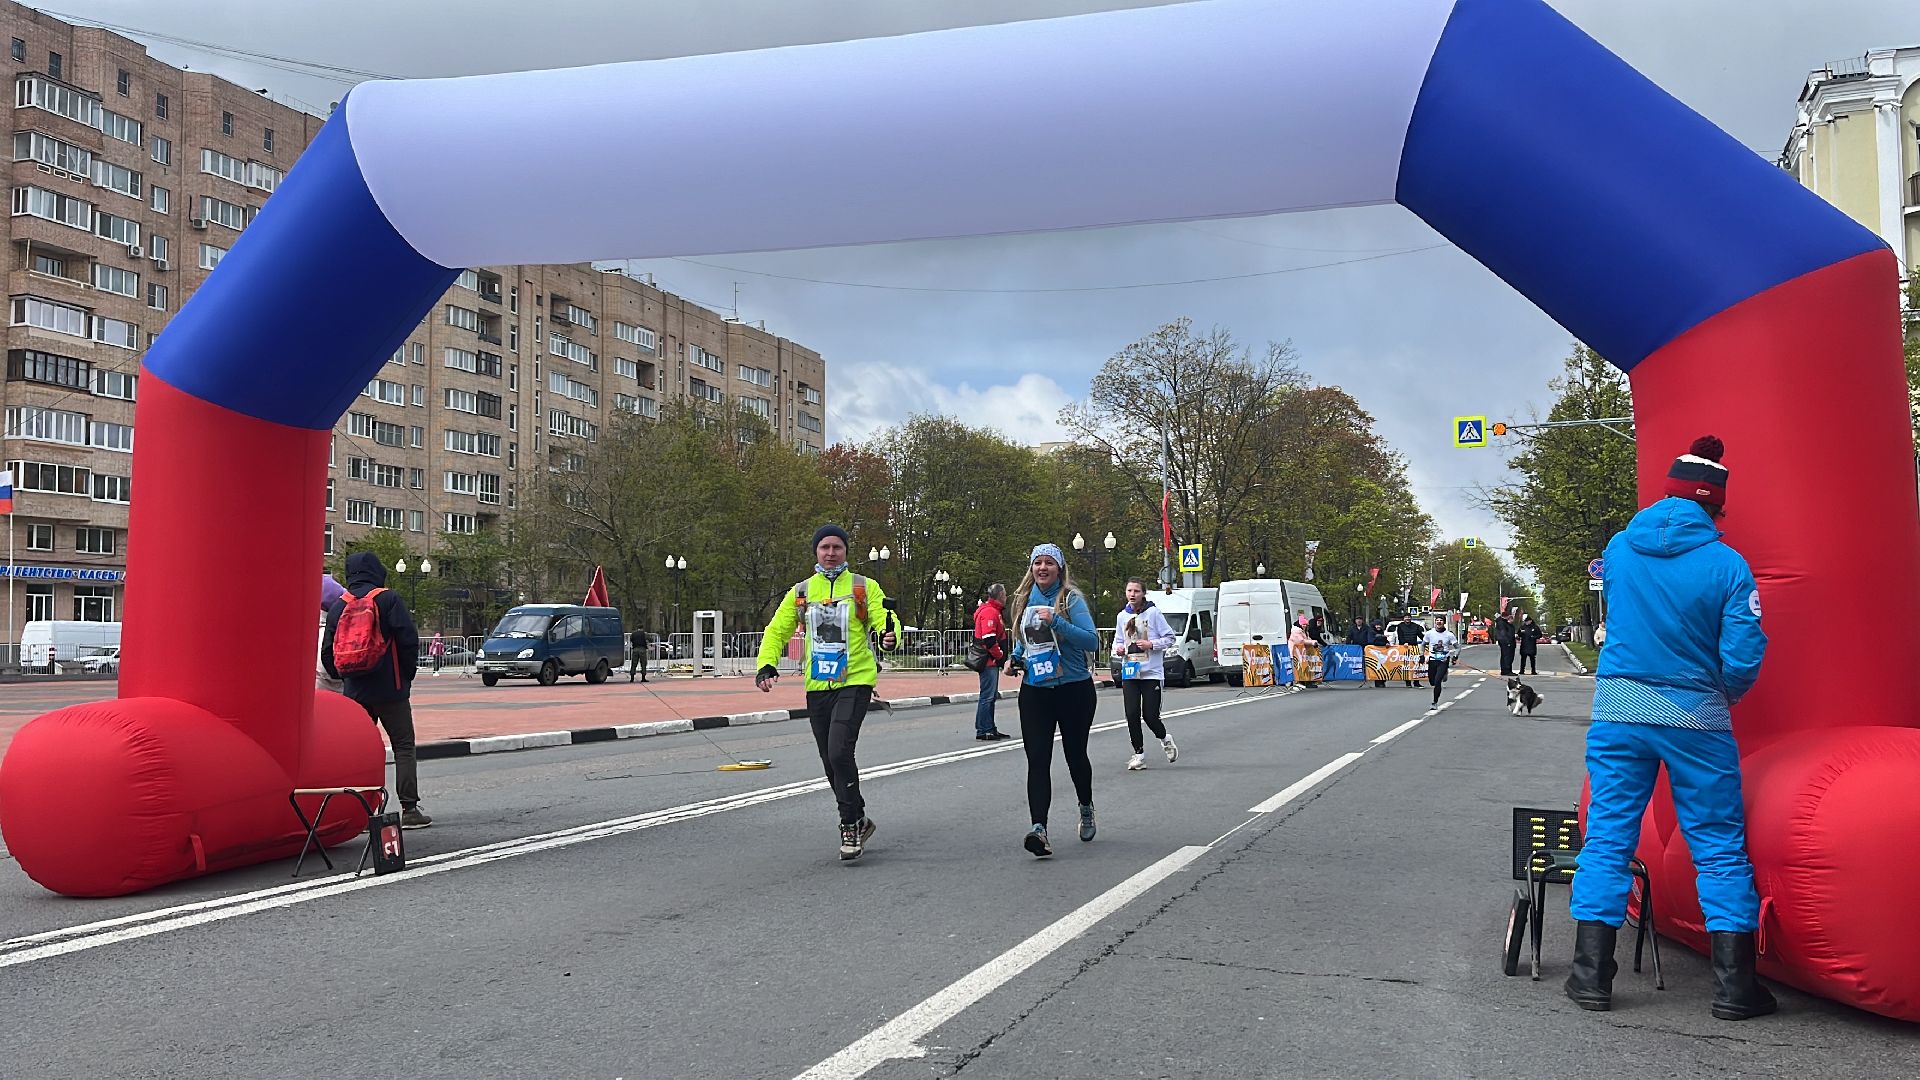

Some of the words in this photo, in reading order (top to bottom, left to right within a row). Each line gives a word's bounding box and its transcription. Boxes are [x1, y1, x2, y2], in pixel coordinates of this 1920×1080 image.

[78, 569, 120, 581] КАССЫ
[818, 660, 839, 675] 157
[1032, 660, 1054, 676] 158
[1124, 666, 1135, 676] 117
